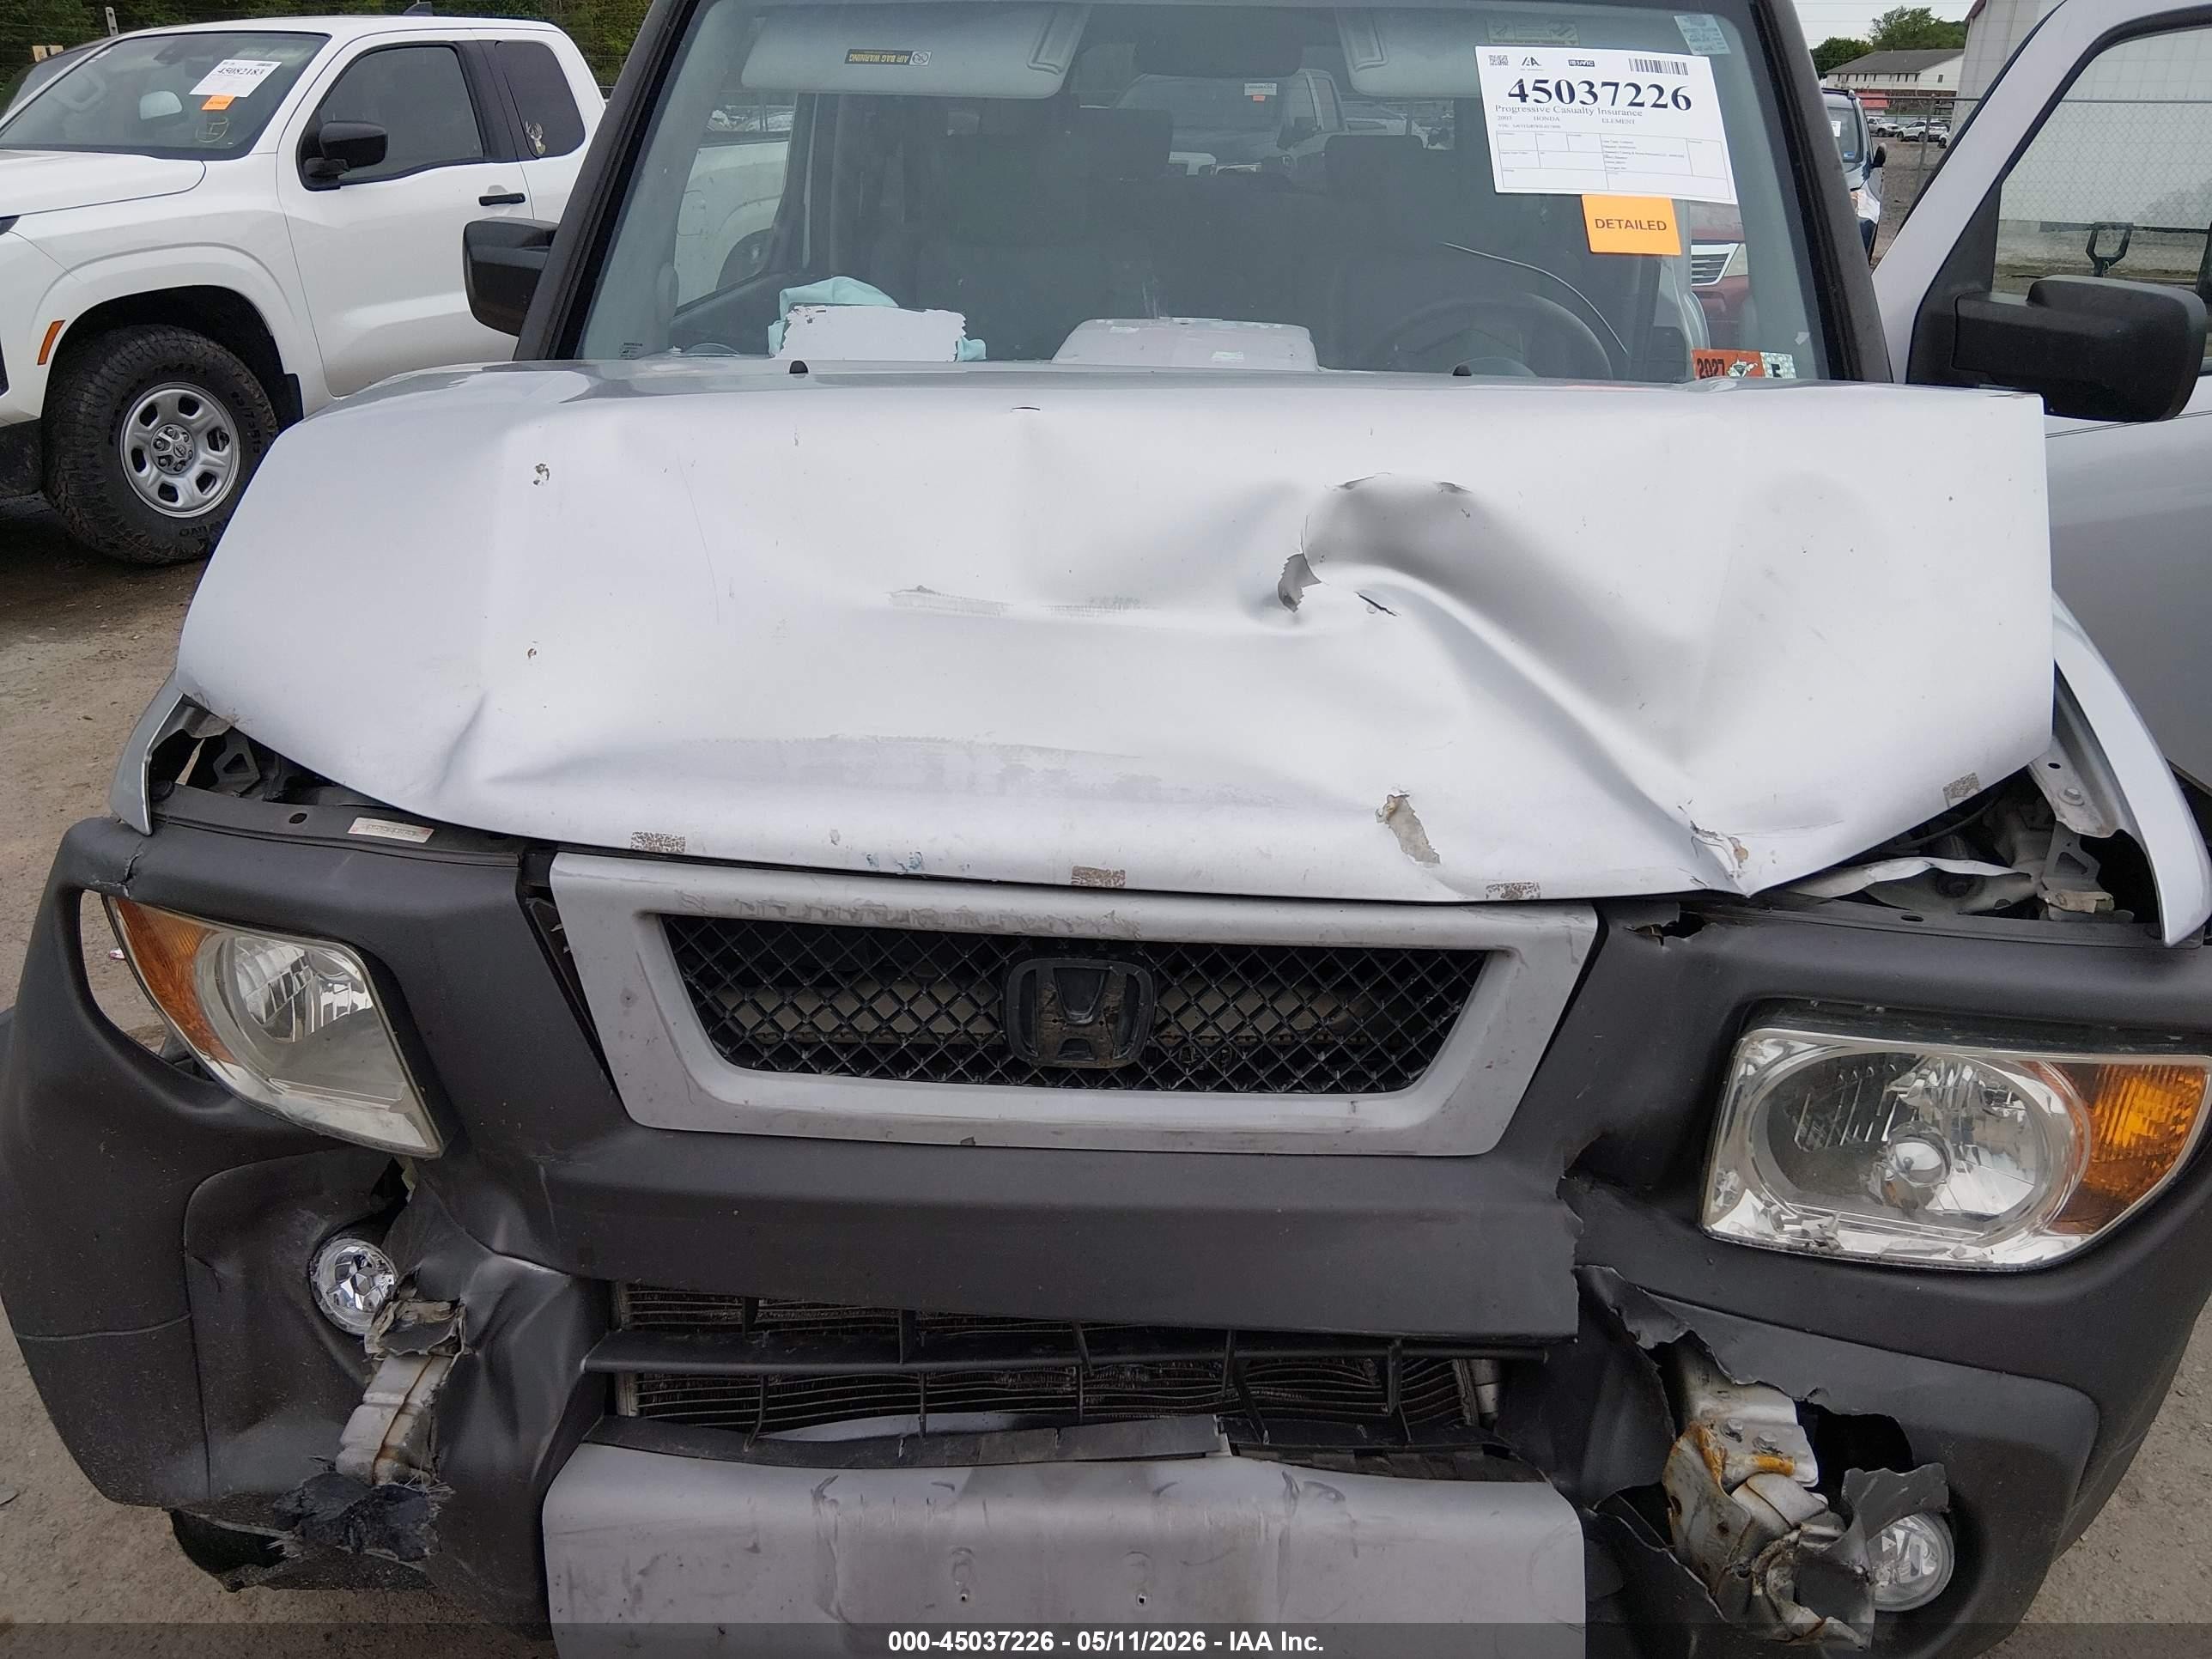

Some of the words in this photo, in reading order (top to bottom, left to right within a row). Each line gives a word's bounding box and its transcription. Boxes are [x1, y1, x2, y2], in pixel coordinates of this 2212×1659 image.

[848, 53, 880, 63] WARNING
[881, 54, 896, 63] BAG
[896, 54, 909, 64] AIR
[1508, 78, 1692, 111] 45037226
[1495, 104, 1551, 113] Progressive
[1553, 105, 1595, 116] Casualty
[1597, 106, 1643, 117] Insurance
[1595, 218, 1668, 231] DETAILED
[1696, 357, 1725, 378] 2027
